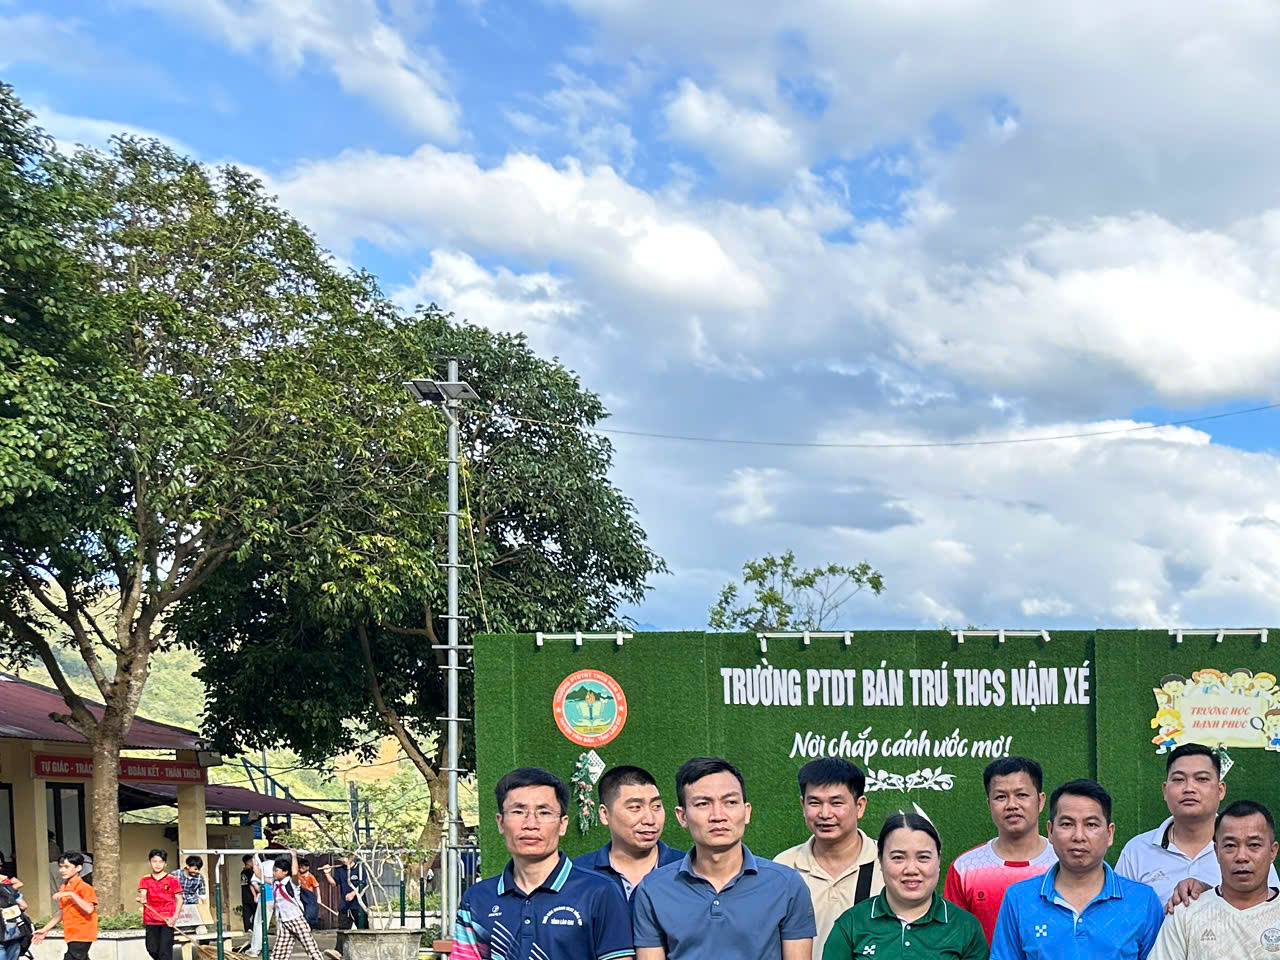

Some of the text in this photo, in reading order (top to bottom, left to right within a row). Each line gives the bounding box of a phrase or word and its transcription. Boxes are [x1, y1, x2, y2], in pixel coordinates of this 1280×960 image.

[720, 658, 1091, 713] TRƯỜNG PTDT BÁN TRÚ THCS NẬM XÉ
[789, 726, 1013, 766] Nơi chắp cánh ước mơ!
[41, 760, 51, 773] TỰ
[52, 759, 69, 773] GIÁC
[75, 762, 94, 774] TRÁC
